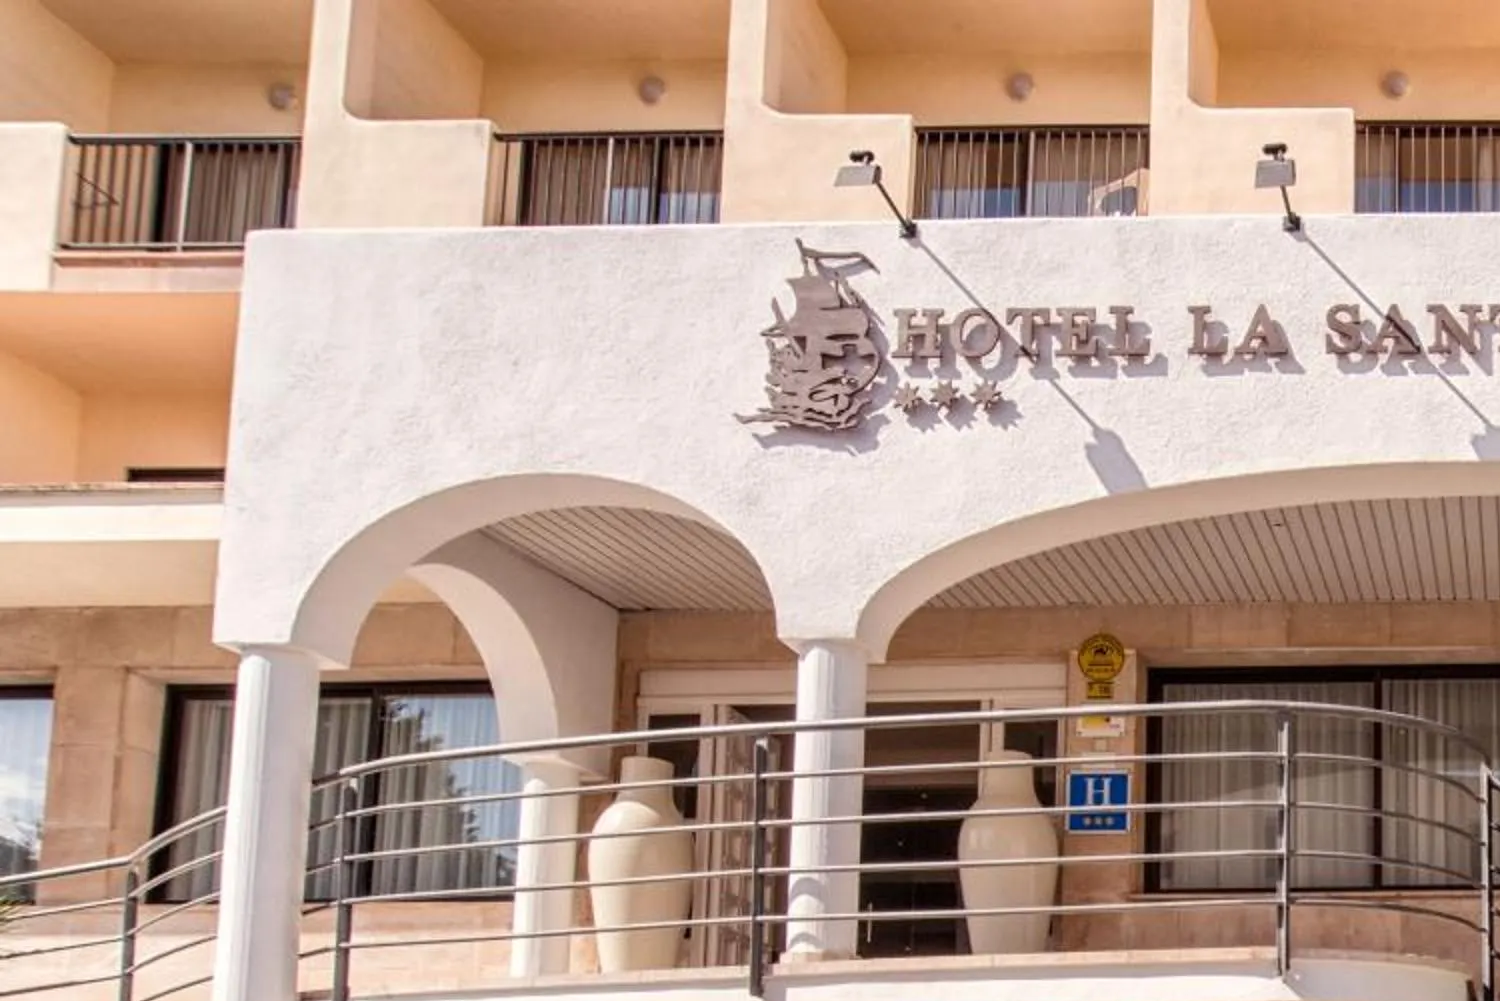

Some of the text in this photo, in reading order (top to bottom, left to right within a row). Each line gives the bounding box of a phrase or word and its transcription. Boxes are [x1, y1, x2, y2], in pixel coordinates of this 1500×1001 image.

[890, 306, 1151, 358] HOTEL
[1186, 303, 1289, 356] LA
[1085, 777, 1112, 806] H
